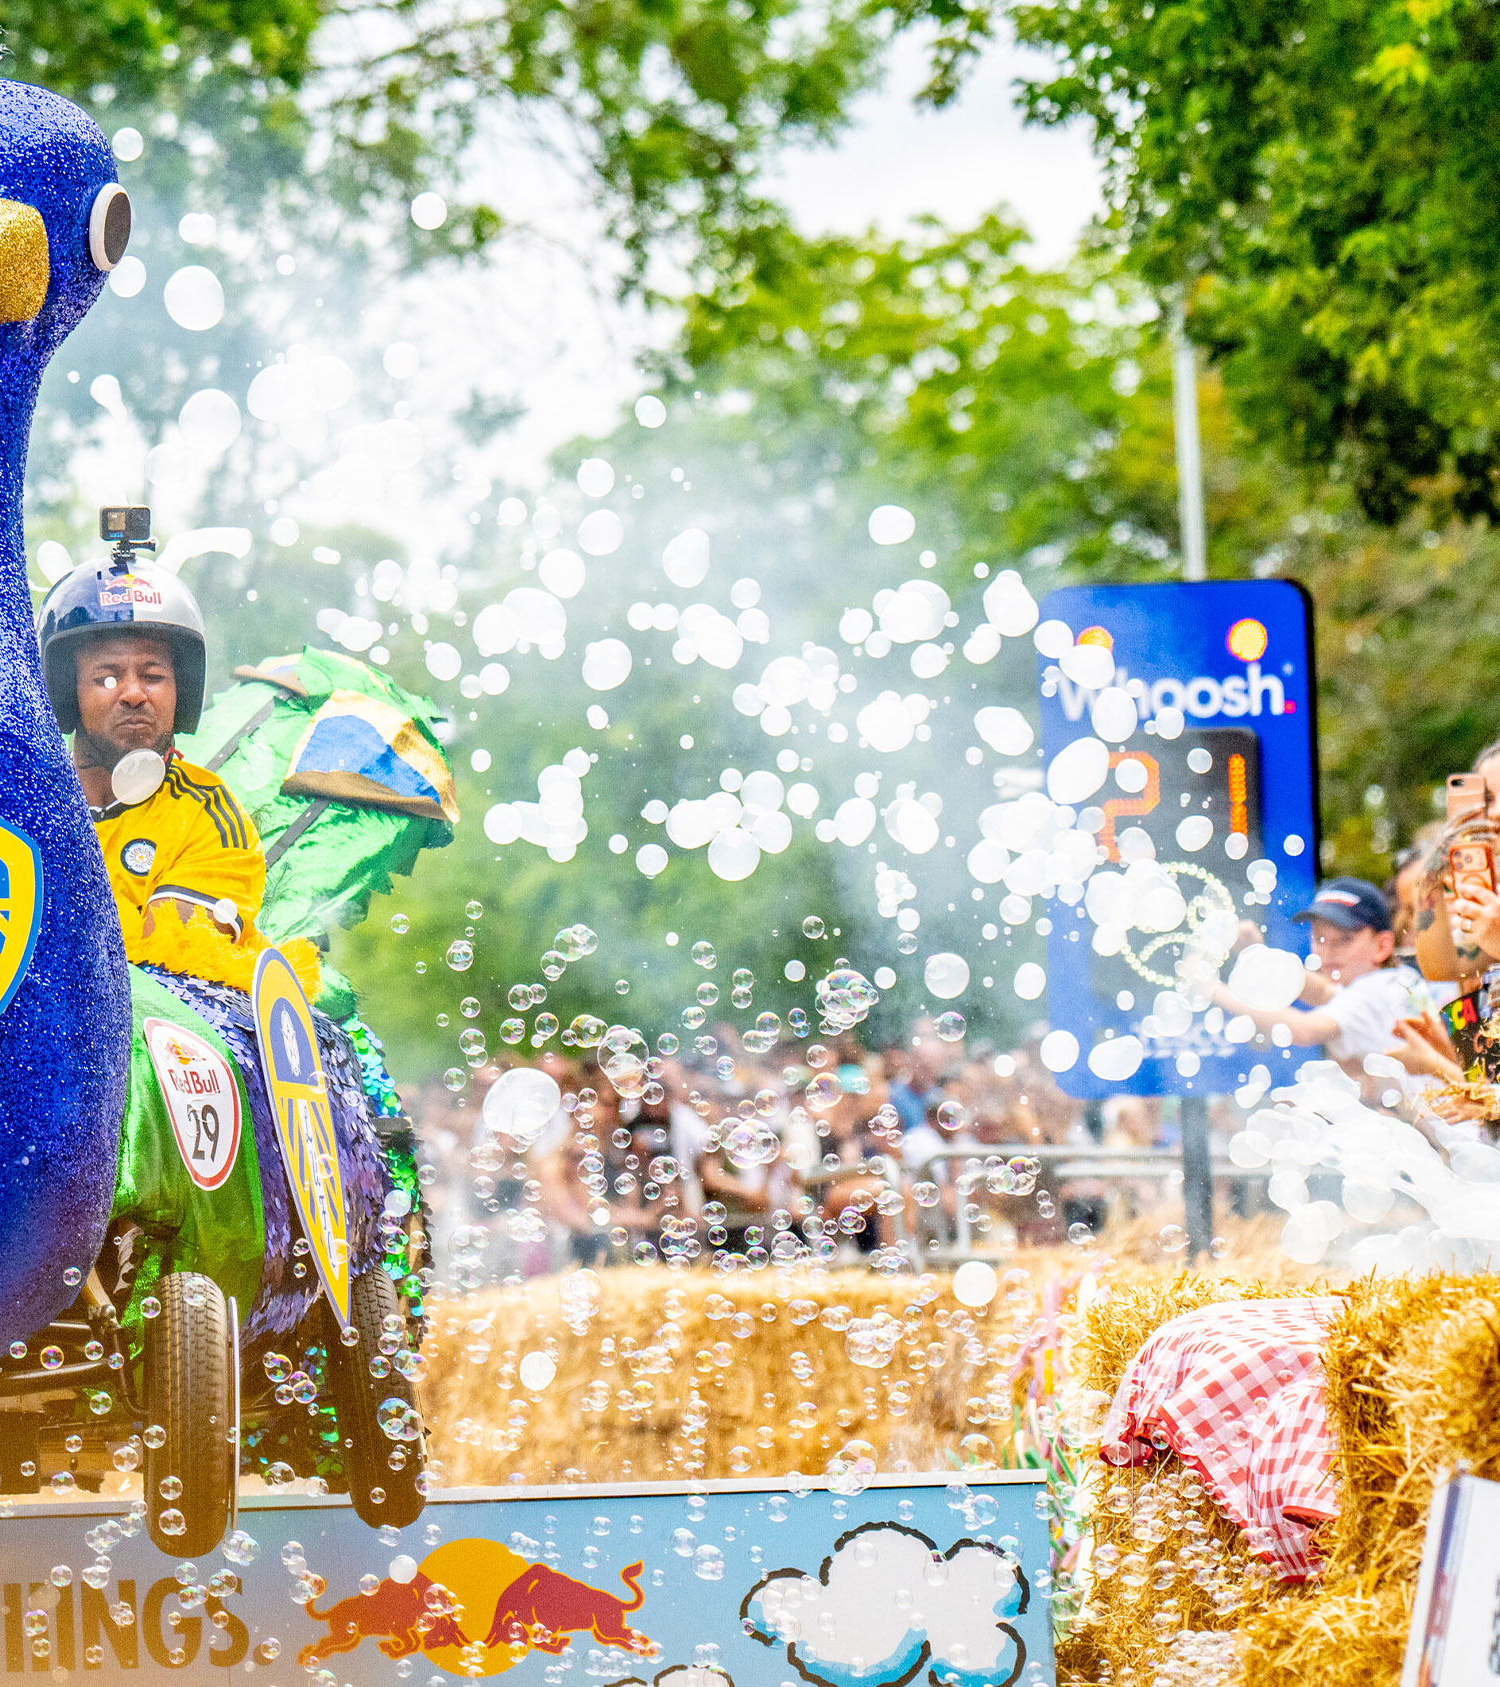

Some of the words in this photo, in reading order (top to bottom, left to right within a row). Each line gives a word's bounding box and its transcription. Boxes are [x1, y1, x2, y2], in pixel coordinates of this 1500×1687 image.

[102, 589, 131, 605] Red
[133, 590, 162, 605] Bull
[168, 1069, 191, 1093] Red
[192, 1069, 220, 1094] Bull
[187, 1103, 220, 1163] 29
